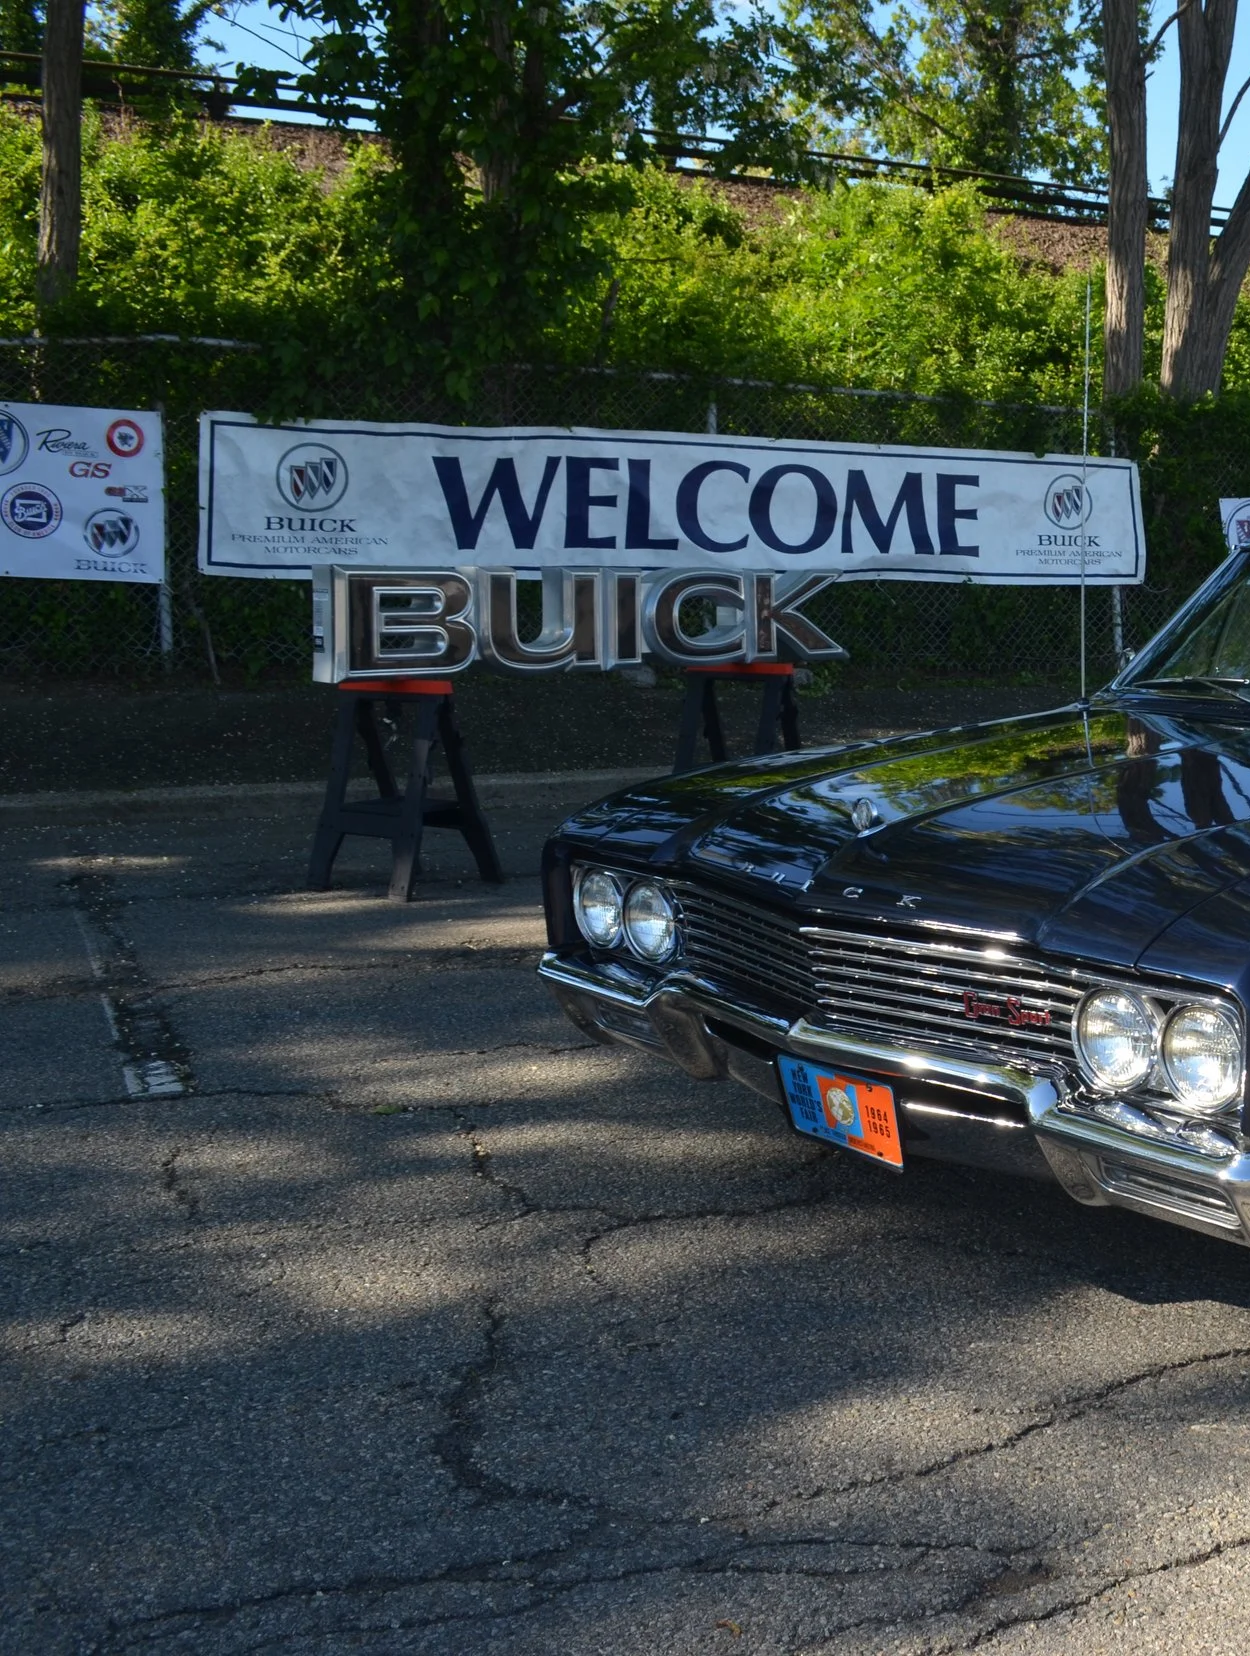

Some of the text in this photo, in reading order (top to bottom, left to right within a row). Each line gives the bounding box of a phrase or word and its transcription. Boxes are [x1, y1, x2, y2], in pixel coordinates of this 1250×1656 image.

[69, 461, 112, 479] GS
[431, 455, 980, 558] WELCOME
[264, 516, 357, 533] BUICK
[232, 533, 389, 546] PREMIUM AMERICAN
[1037, 534, 1101, 547] BUICK
[264, 546, 358, 556] MOTORCARS
[1015, 549, 1066, 557] PREMIUM
[74, 559, 148, 574] BUICK
[313, 563, 850, 684] BUICK
[739, 862, 922, 909] BUICK
[1007, 996, 1052, 1026] Sport
[864, 1105, 889, 1124] 1964
[867, 1119, 892, 1139] 1965
